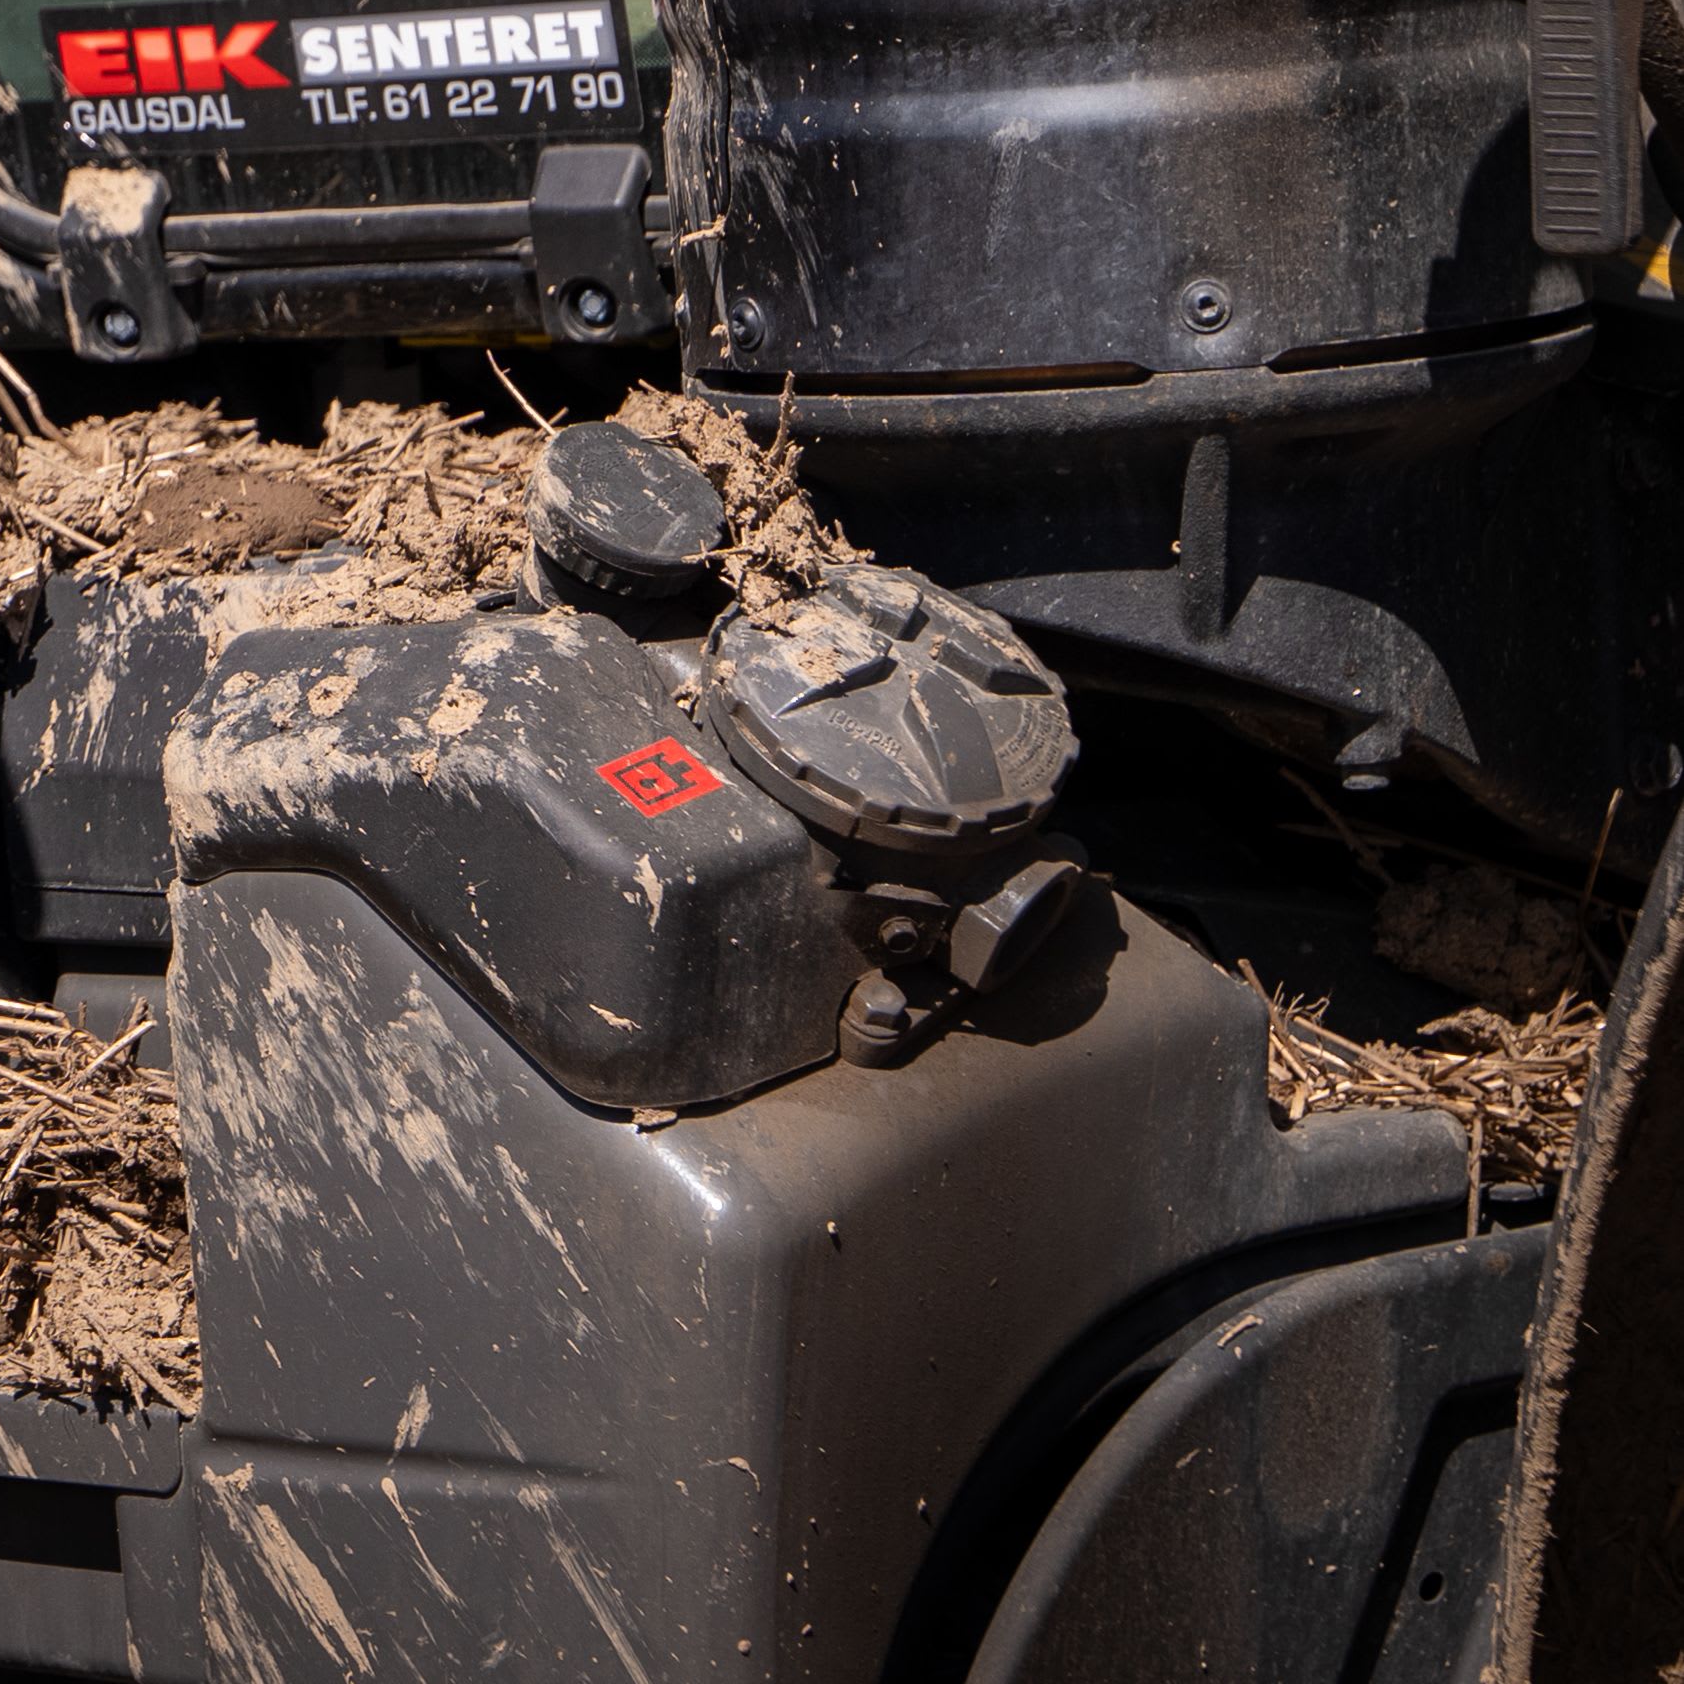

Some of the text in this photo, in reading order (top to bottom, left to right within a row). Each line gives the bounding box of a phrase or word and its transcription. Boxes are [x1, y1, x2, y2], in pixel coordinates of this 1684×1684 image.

[58, 10, 603, 97] EIK SENTERET
[69, 93, 246, 134] GAUSDAL
[301, 71, 625, 125] TLF. 61 22 71 90
